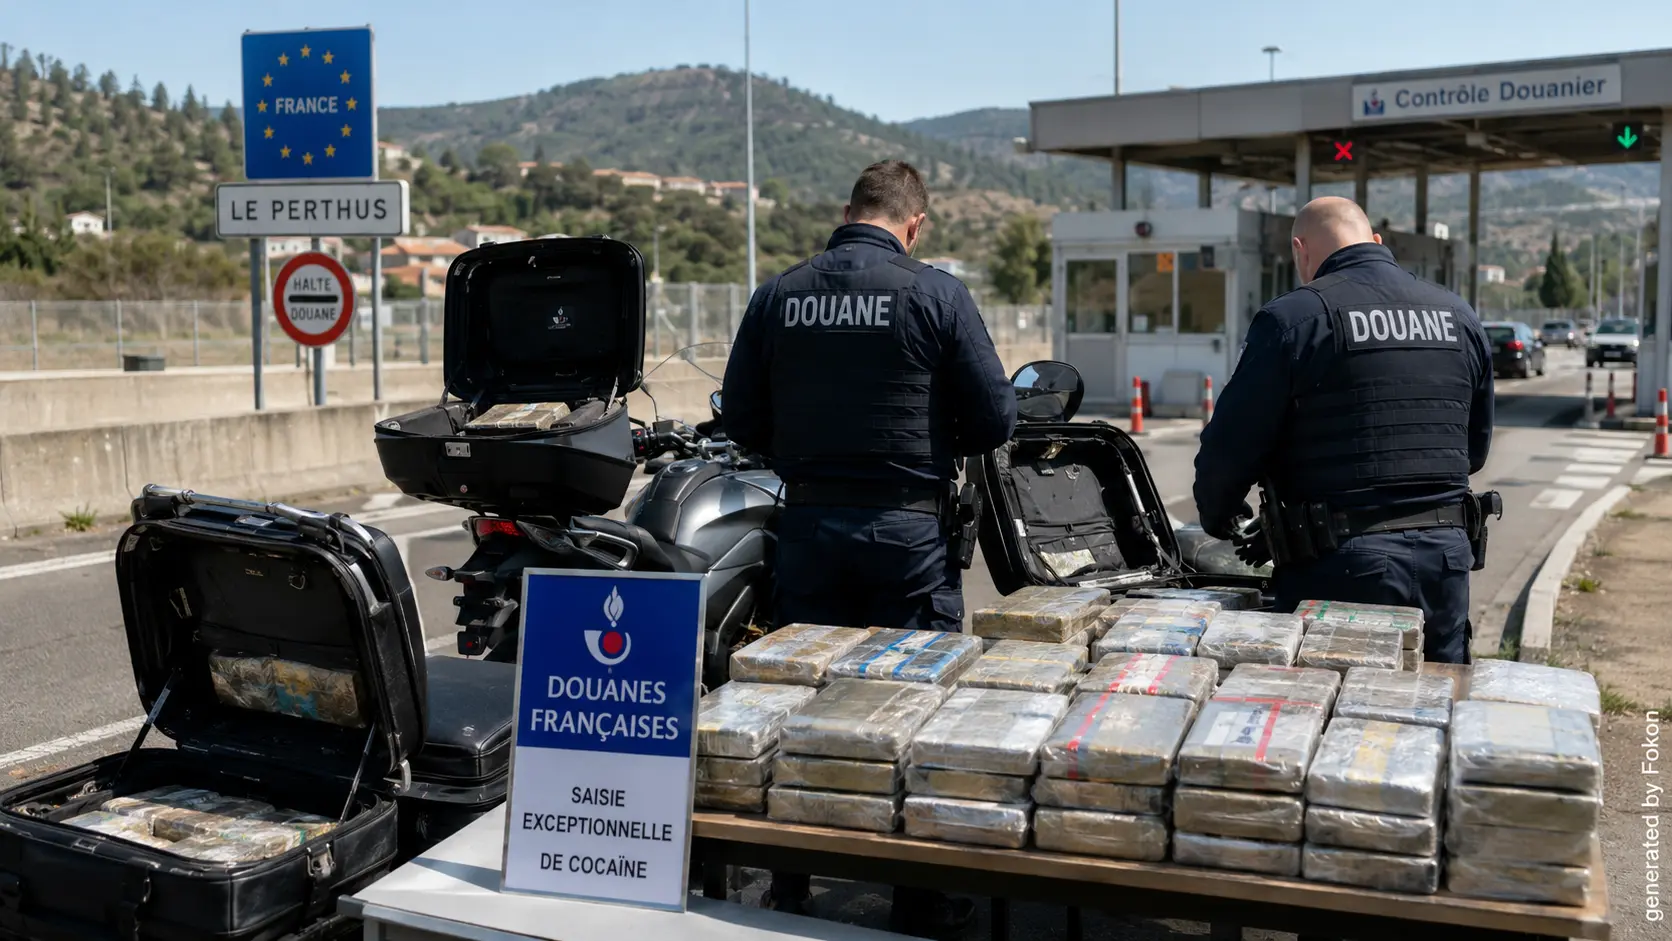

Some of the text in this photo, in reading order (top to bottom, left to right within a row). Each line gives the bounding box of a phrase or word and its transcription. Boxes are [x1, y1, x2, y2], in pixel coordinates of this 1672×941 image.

[275, 96, 339, 114] FRANCE
[1395, 75, 1607, 109] Contrôle Douanier
[231, 199, 387, 221] LE PERTHUS
[293, 278, 332, 292] HALTE
[290, 308, 337, 322] DOUANE
[784, 295, 892, 328] DOUANE
[1348, 309, 1458, 343] DOUANE
[547, 675, 667, 705] DOUANES
[530, 708, 680, 742] FRANÇAISES
[571, 786, 626, 808] SAISIE
[522, 812, 673, 842] EXCEPTIONNELLE
[540, 852, 648, 879] DE COCAÏNE
